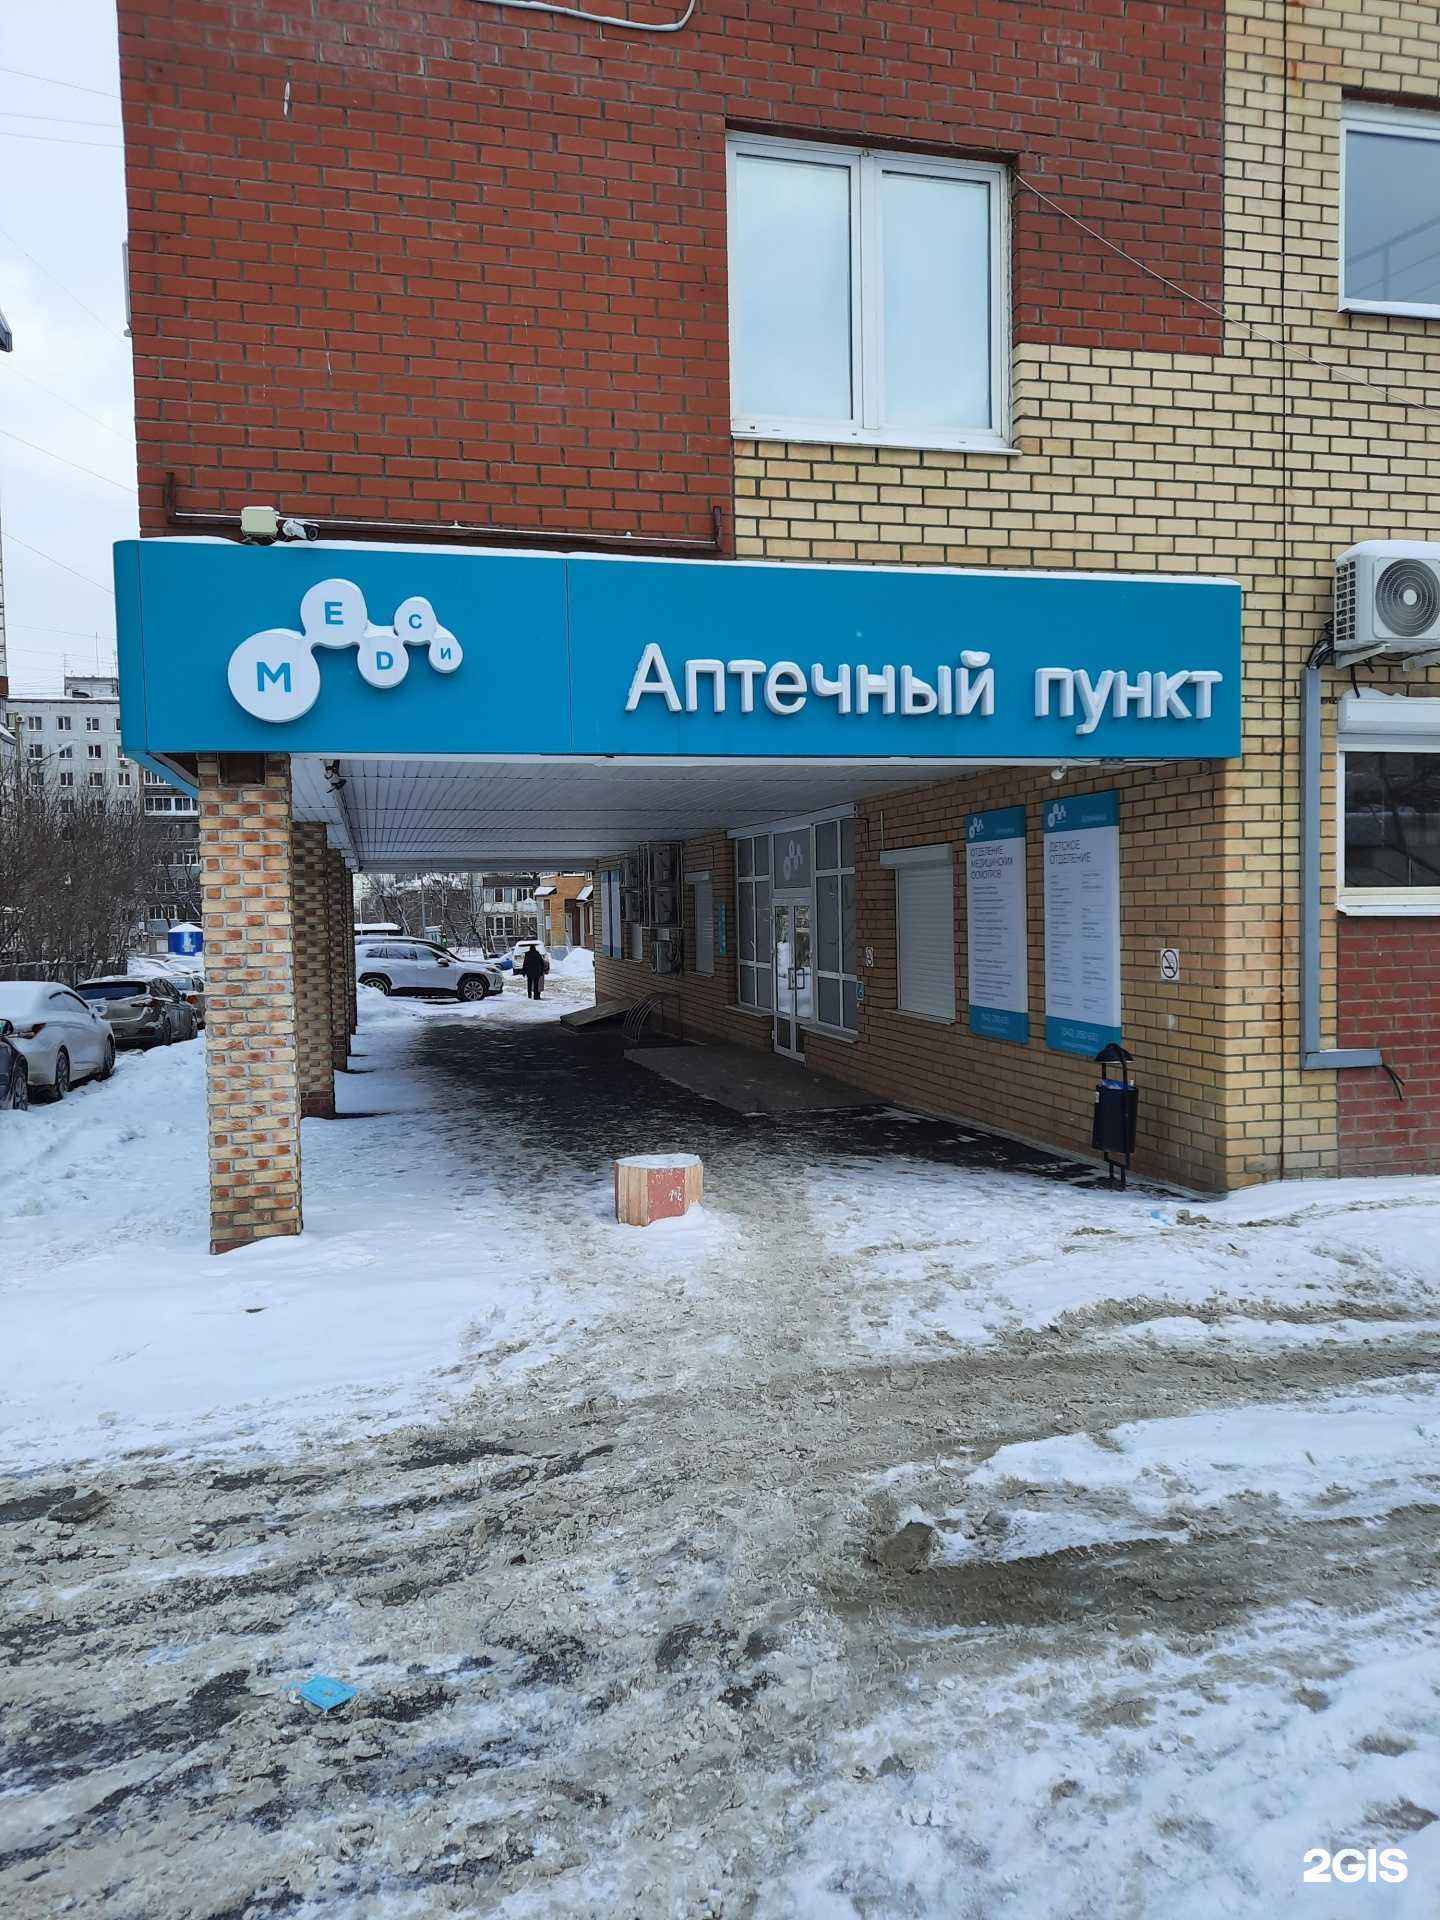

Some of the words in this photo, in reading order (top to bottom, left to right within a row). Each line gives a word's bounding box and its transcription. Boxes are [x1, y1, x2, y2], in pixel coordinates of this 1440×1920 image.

[625, 642, 995, 717] Аптечный
[1034, 666, 1224, 735] пункт
[970, 845, 1004, 857] ОТДЕЛЕНИЕ
[1049, 851, 1092, 865] ОТДЕЛЕНИЕ
